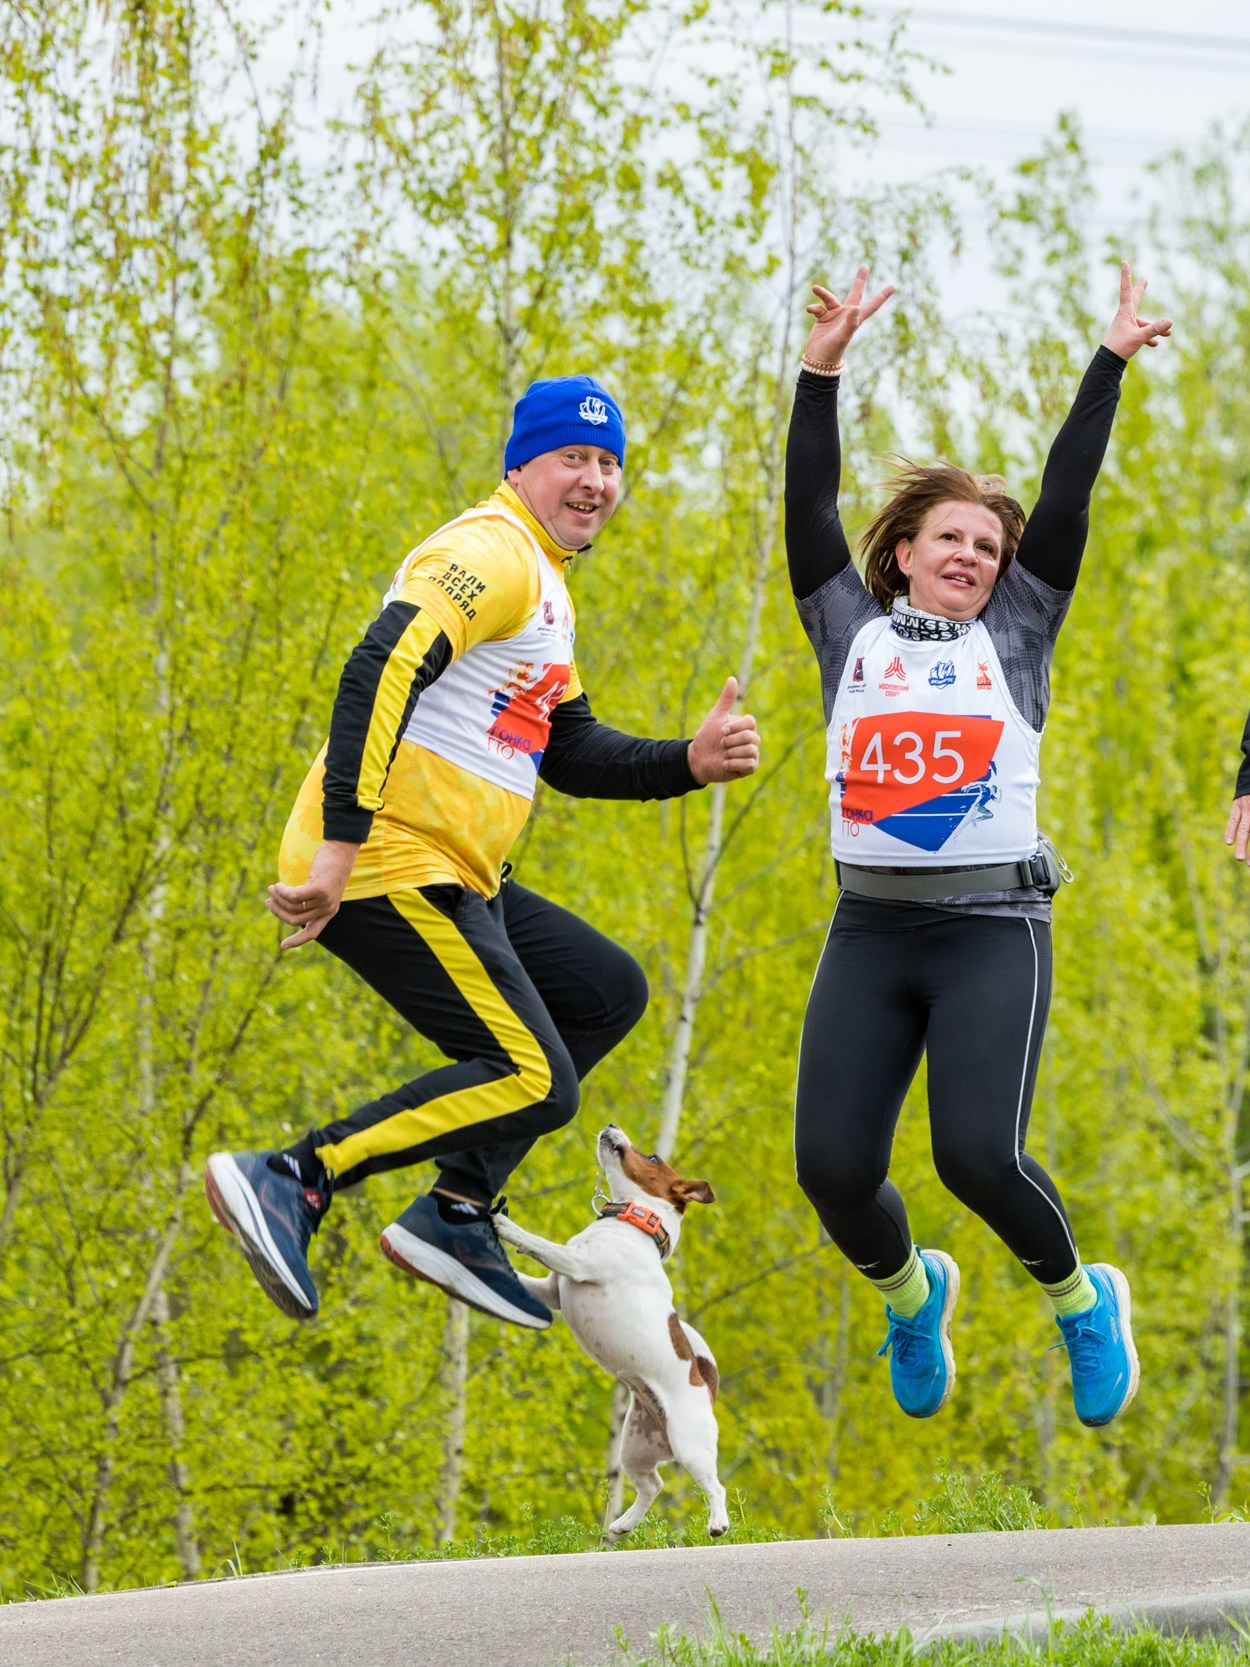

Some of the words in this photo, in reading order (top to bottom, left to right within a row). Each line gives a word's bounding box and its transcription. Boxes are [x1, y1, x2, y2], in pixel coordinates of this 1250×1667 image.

[442, 571, 478, 602] ВСЕХ
[449, 563, 486, 593] ВАЛИ
[487, 736, 514, 760] ГТО
[860, 730, 965, 785] 435
